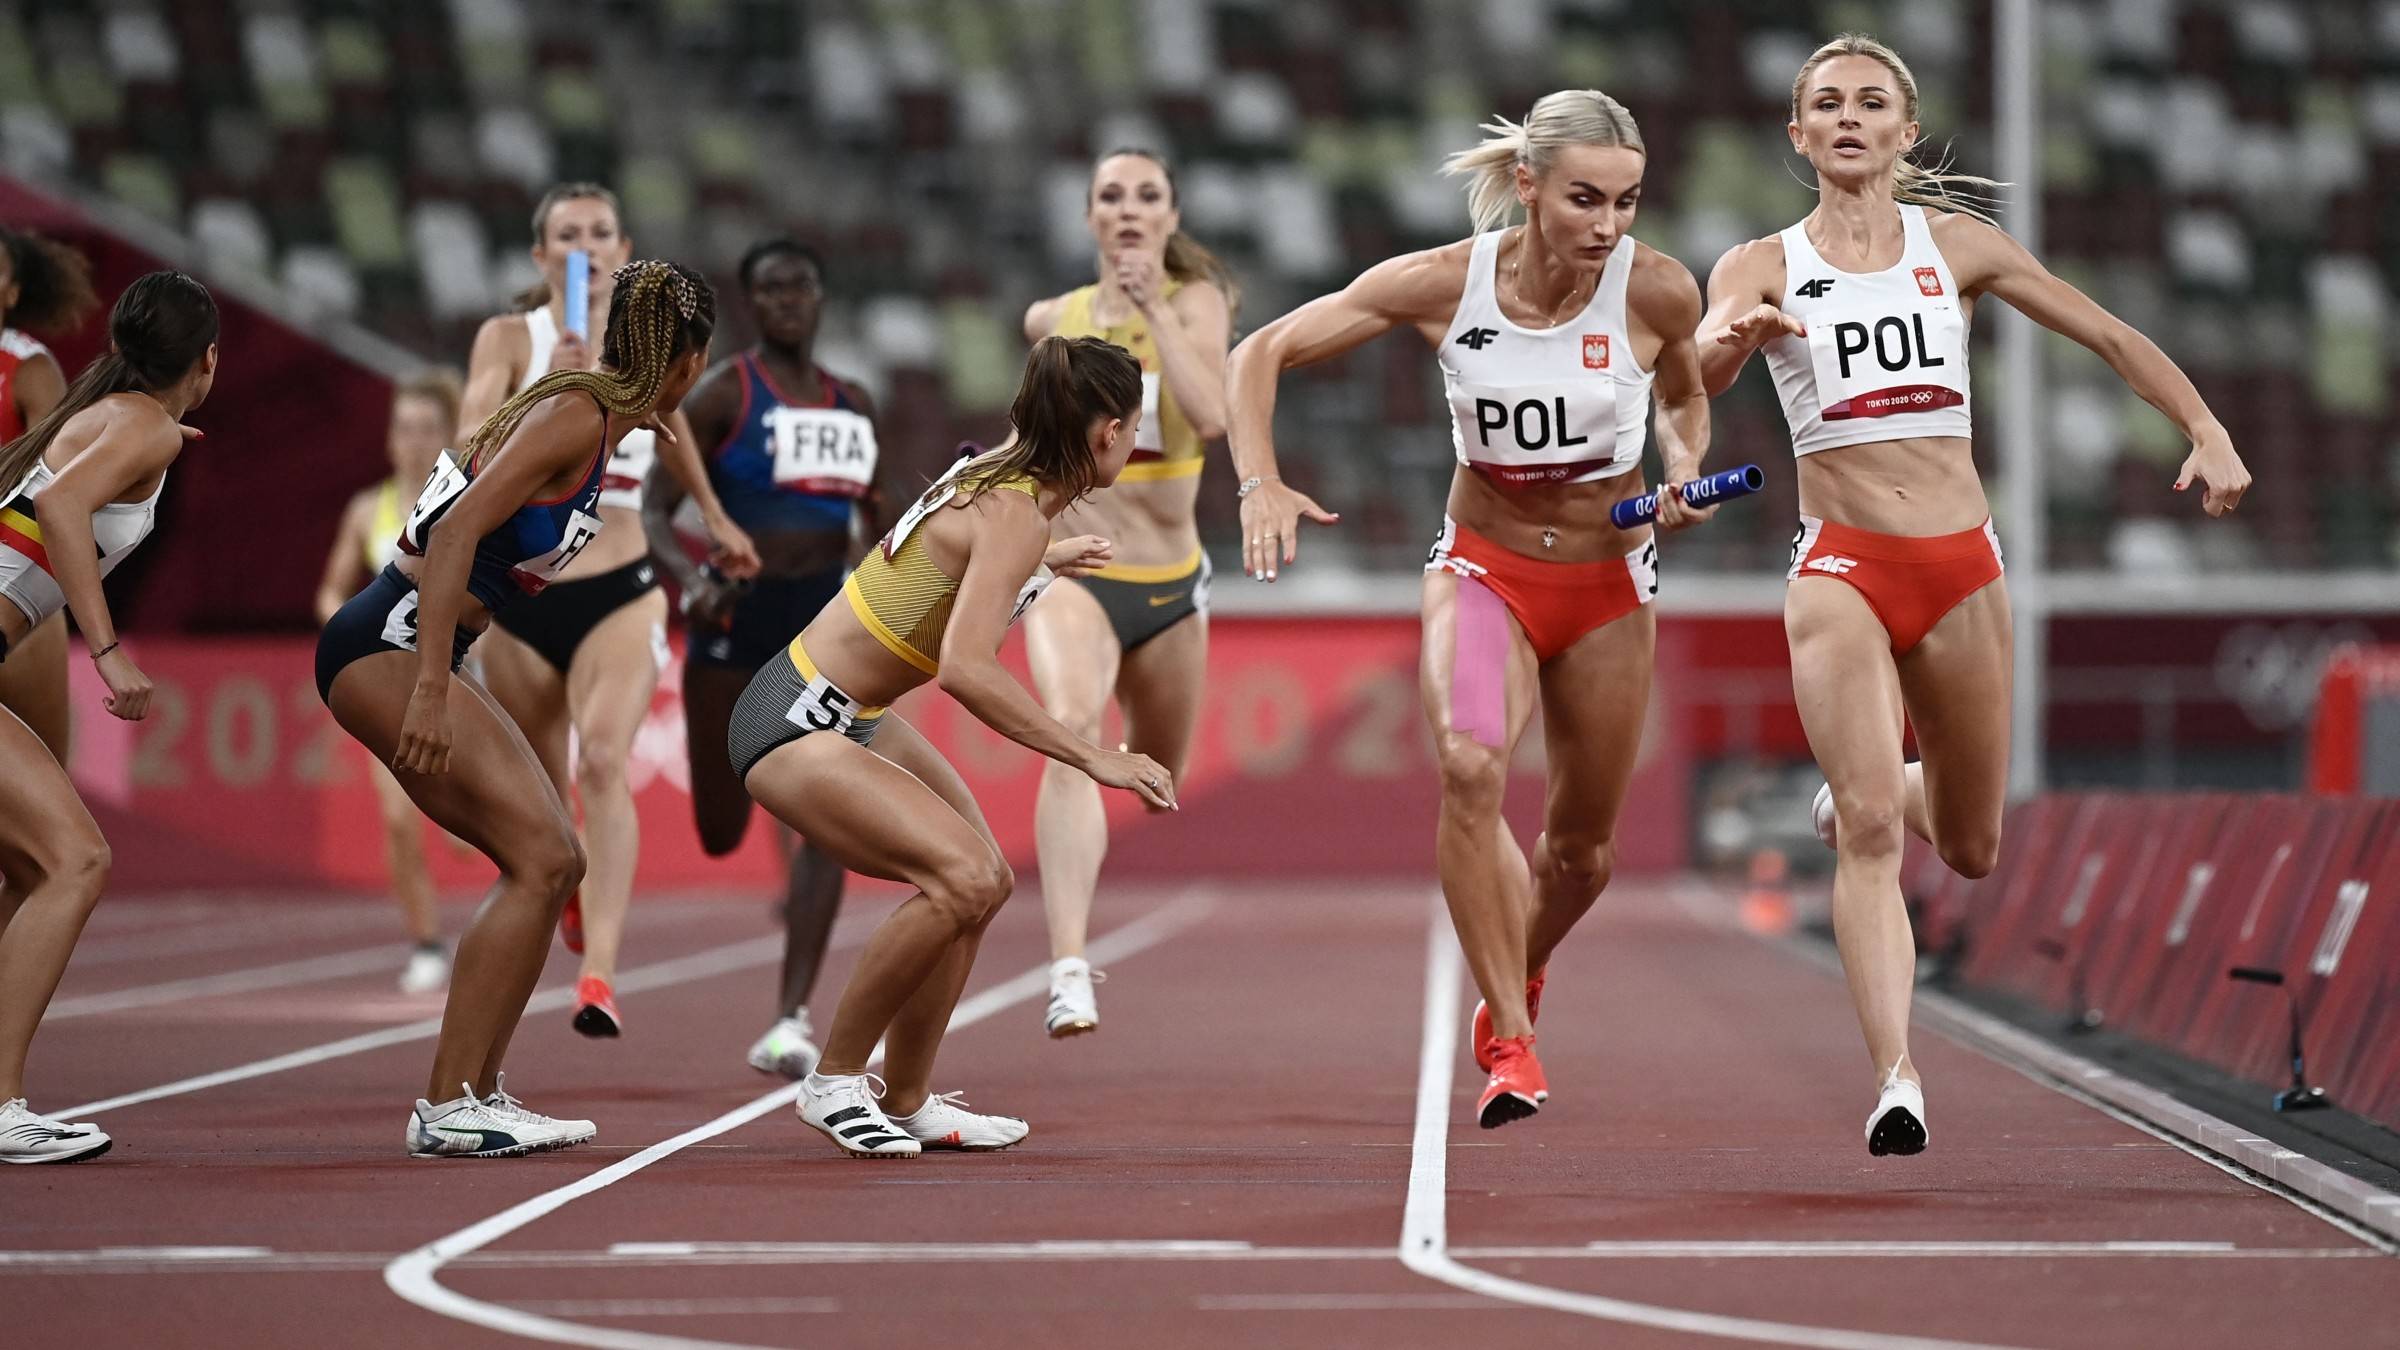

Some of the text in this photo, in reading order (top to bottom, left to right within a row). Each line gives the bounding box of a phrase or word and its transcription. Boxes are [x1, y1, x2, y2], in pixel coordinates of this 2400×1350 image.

[1795, 278, 1836, 298] 4F
[1455, 327, 1500, 350] 4F
[1834, 313, 1945, 379] POL
[1865, 395, 1909, 409] TOKYO 2020
[1476, 397, 1588, 451] POL
[793, 422, 865, 462] FRA
[1502, 471, 1545, 481] TOKYO 2020
[1806, 554, 1858, 574] 4F
[805, 685, 850, 731] 5
